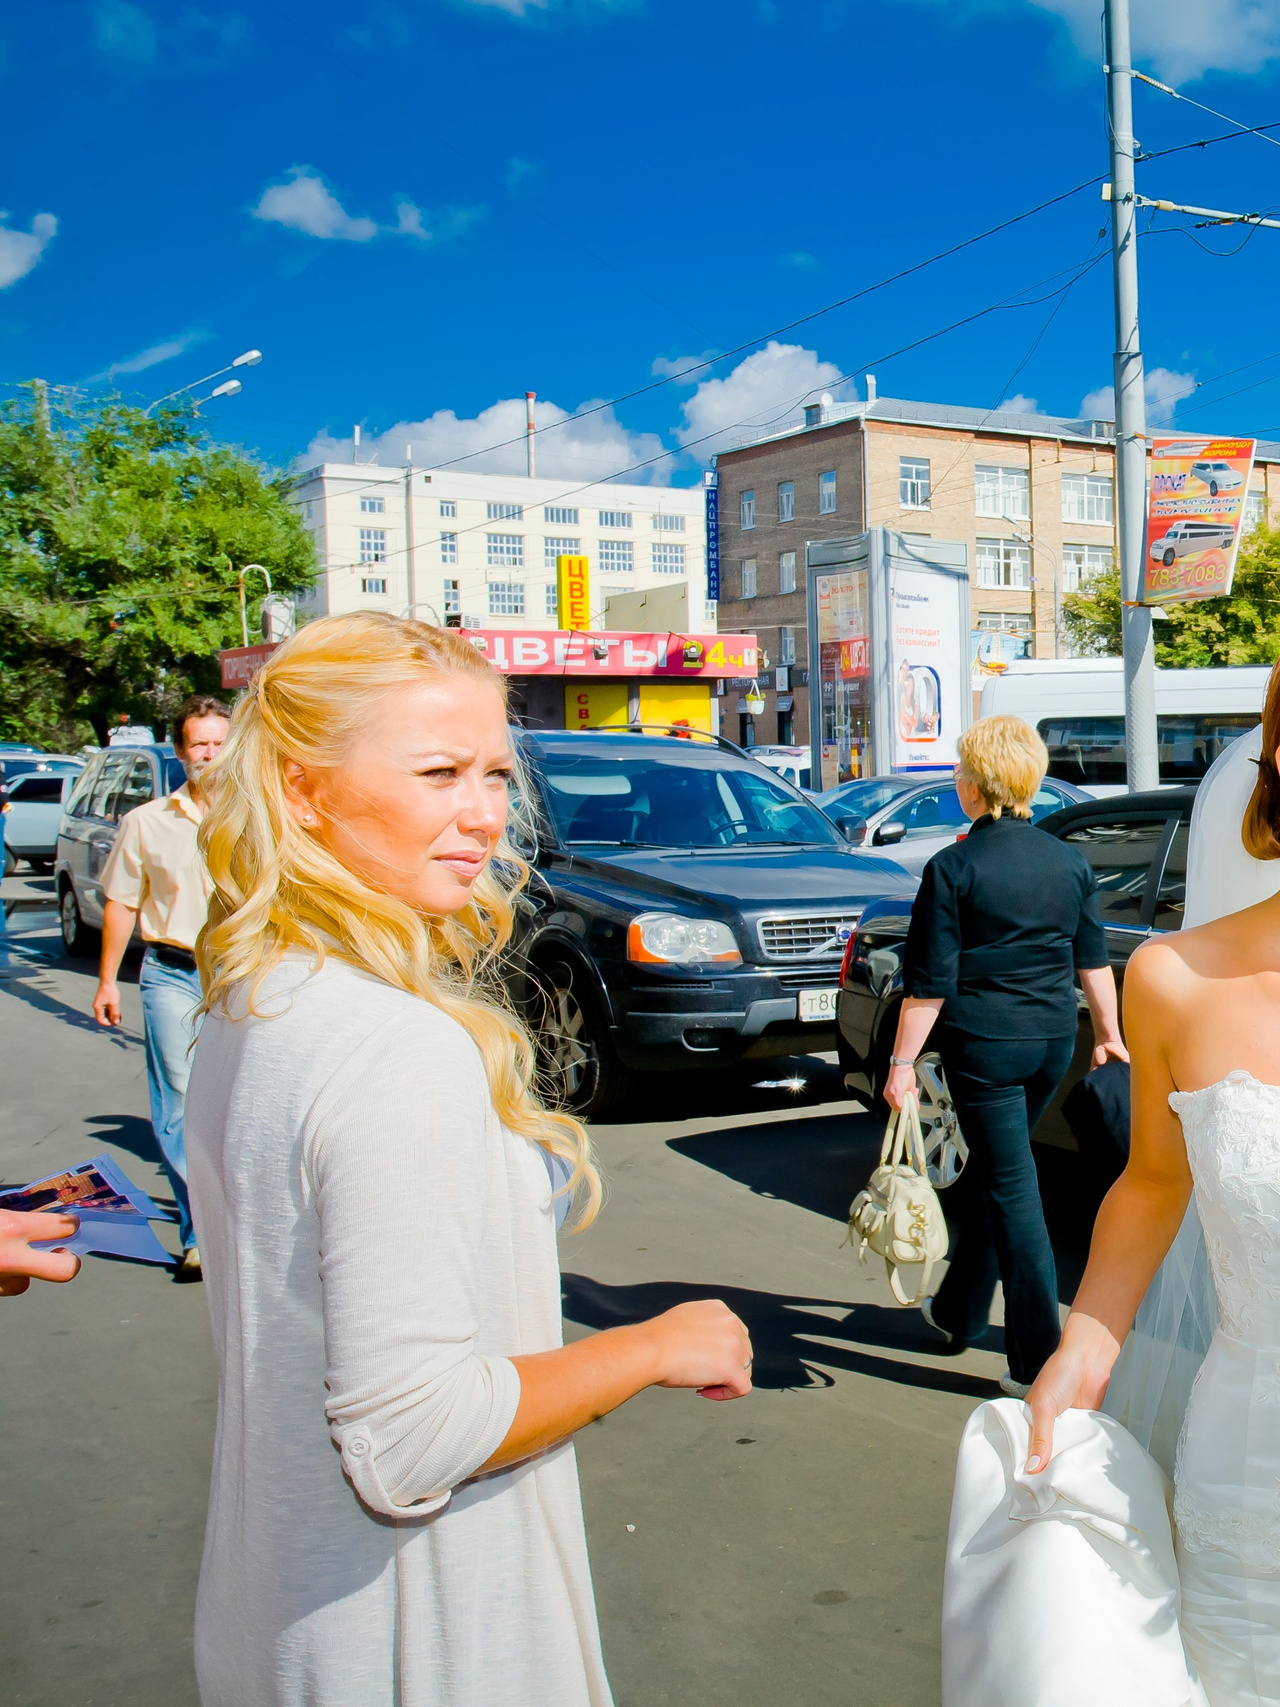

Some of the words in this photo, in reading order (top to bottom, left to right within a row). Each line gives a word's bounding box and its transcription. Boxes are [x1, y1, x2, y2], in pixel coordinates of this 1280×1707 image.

[1202, 449, 1237, 457] КОРОНА
[708, 492, 717, 598] НАЦПРОМБАНК
[1150, 564, 1227, 586] 783-7083
[916, 628, 940, 637] кредит
